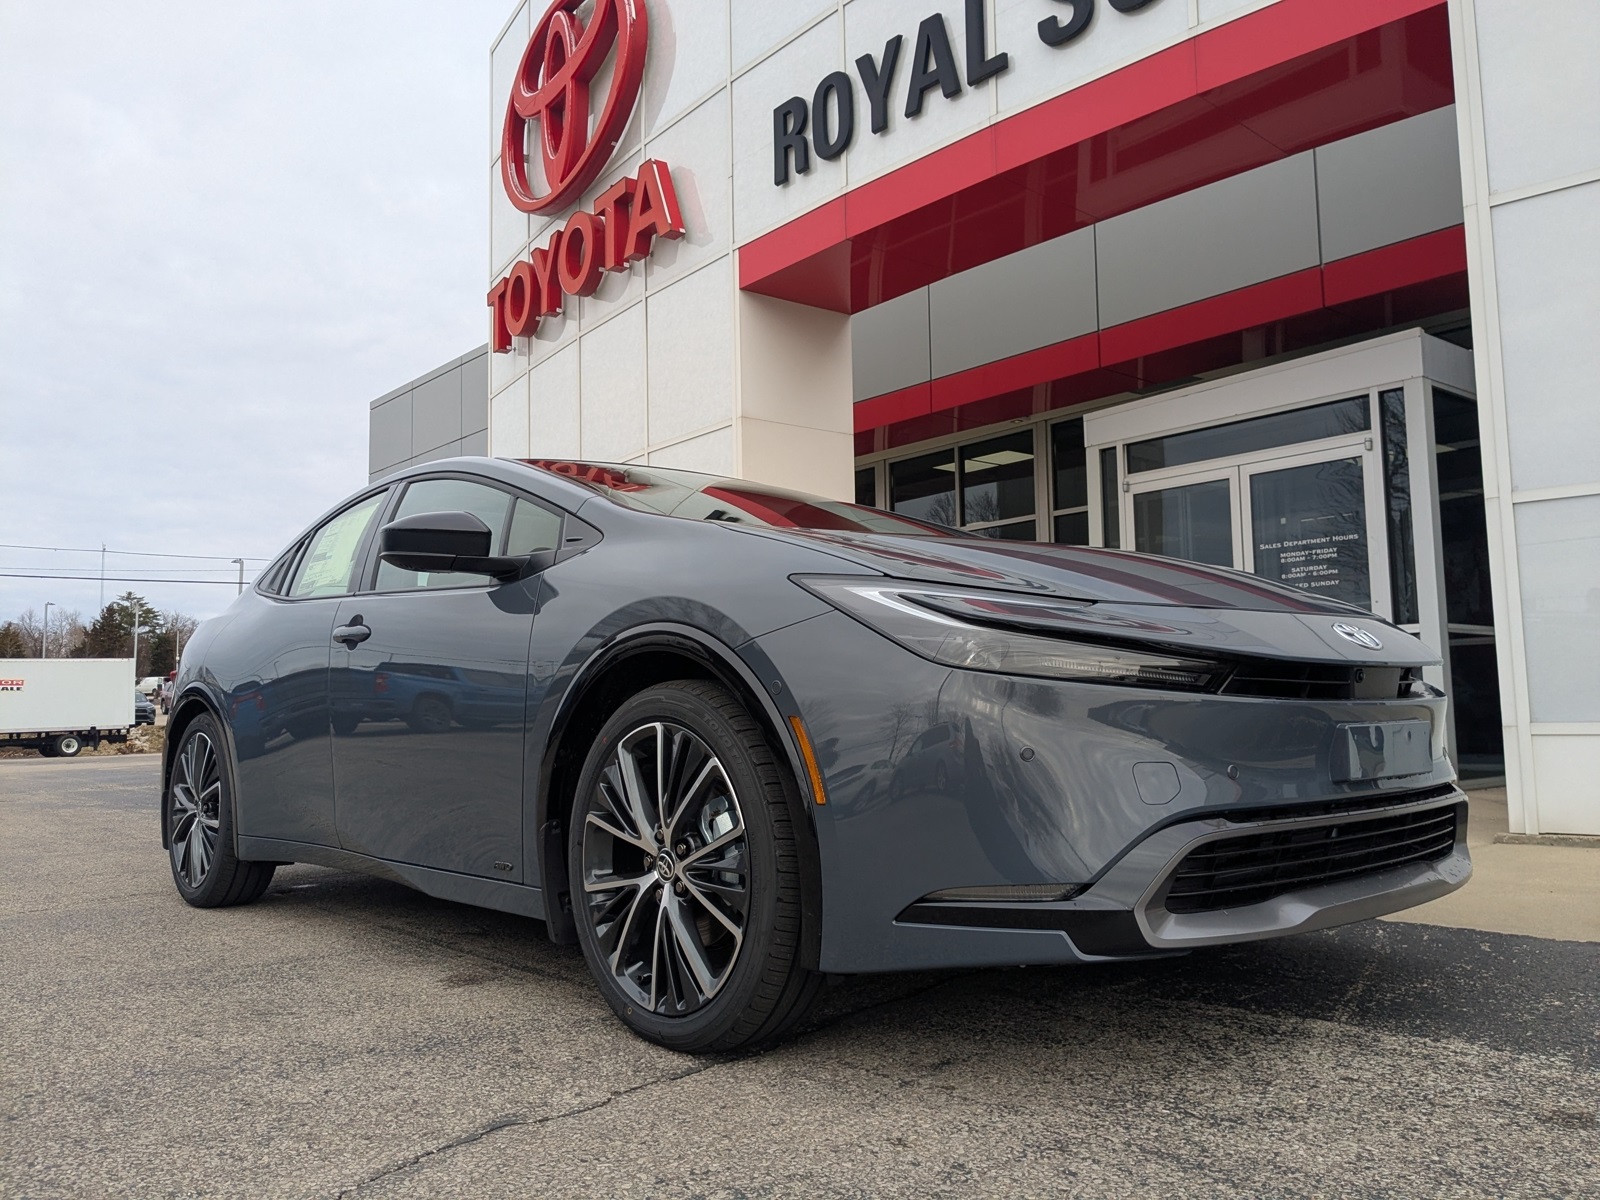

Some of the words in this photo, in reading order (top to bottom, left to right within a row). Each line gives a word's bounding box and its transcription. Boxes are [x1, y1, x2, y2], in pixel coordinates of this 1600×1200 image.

[773, 0, 1008, 187] ROYAL
[487, 158, 685, 354] TOYOTA
[1291, 565, 1327, 573] SATURDAY
